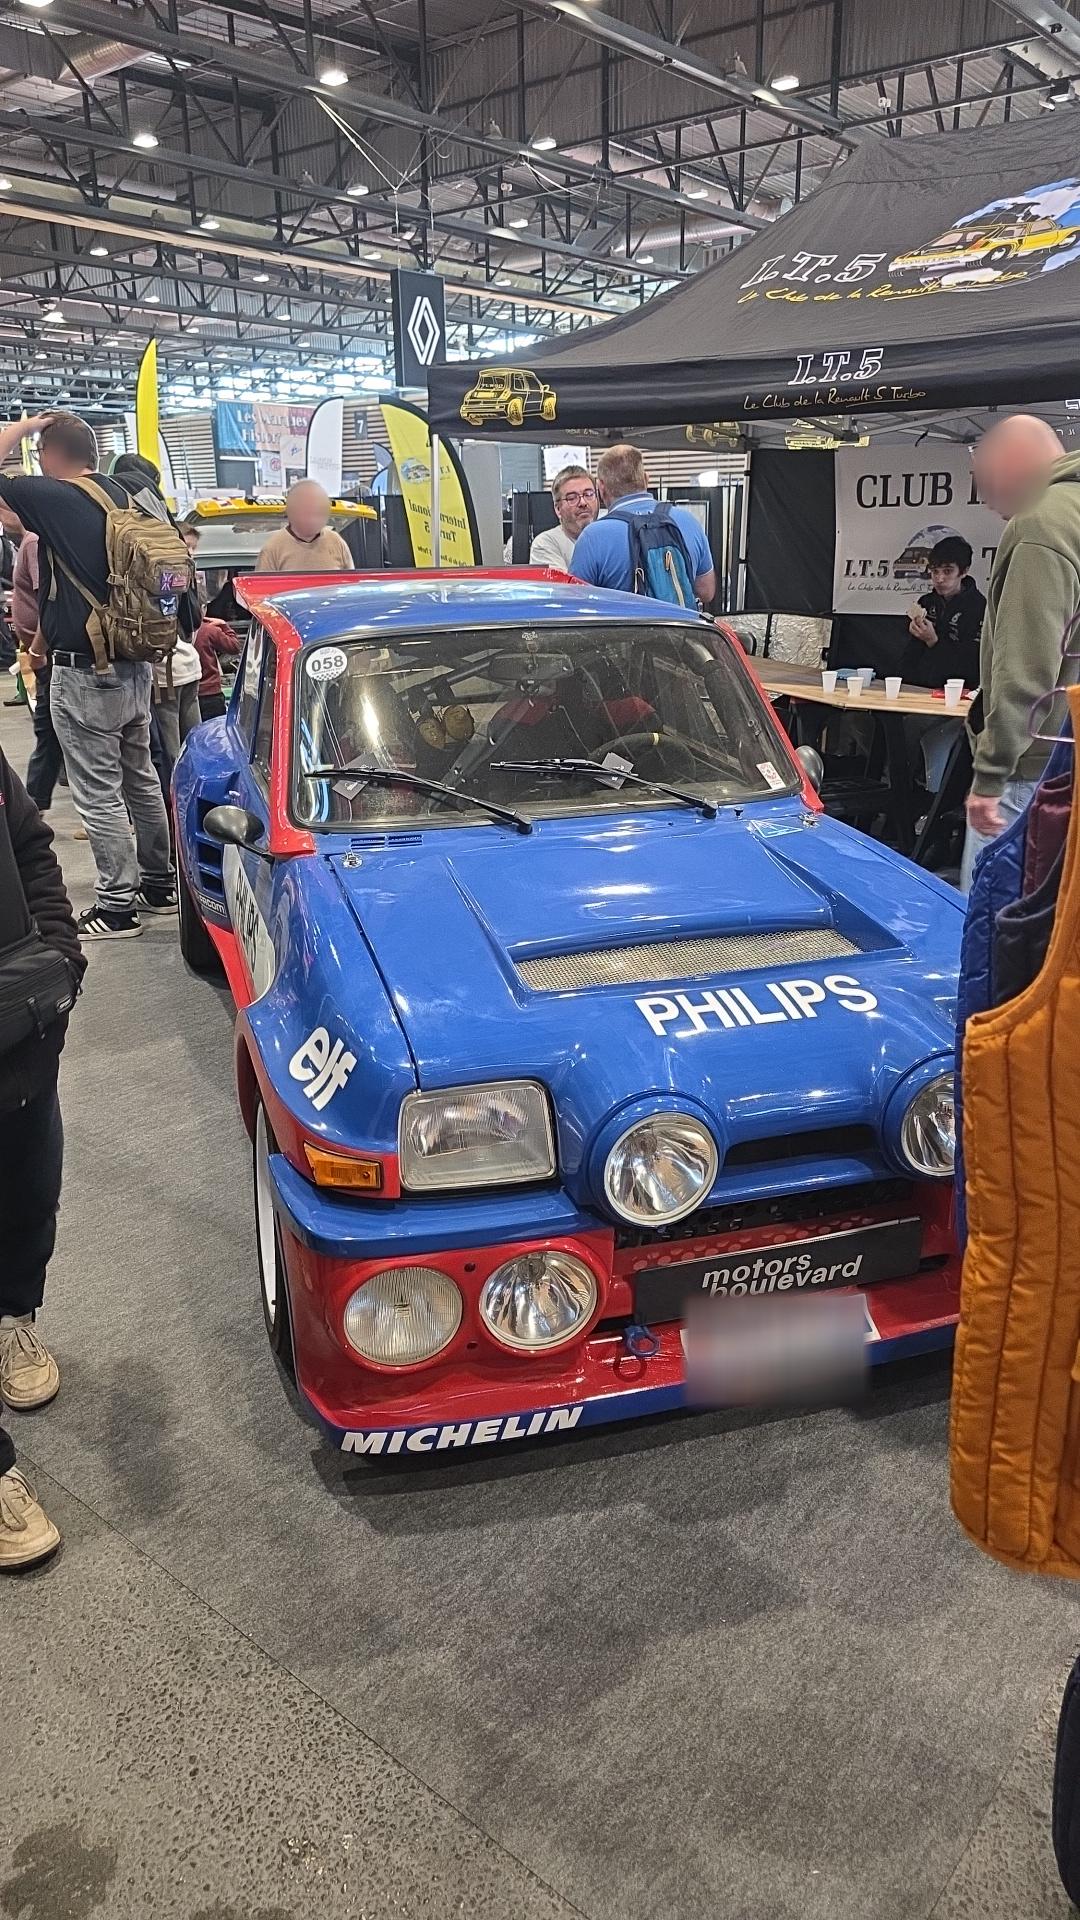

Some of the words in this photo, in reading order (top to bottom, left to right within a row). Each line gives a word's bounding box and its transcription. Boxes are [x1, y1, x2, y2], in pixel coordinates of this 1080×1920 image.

[765, 288, 808, 301] Club
[814, 292, 843, 300] de
[847, 288, 862, 298] la
[788, 348, 884, 385] I.T.5
[743, 395, 760, 410] Le
[763, 394, 790, 408] Club
[794, 396, 813, 407] de
[814, 391, 825, 405] la
[827, 388, 870, 405] Renault
[891, 386, 927, 401] Turbo
[357, 419, 364, 434] 7
[856, 472, 953, 508] CLUB
[844, 559, 889, 577] I.T.5
[311, 655, 344, 672] 058
[634, 974, 878, 1037] PHILIPS
[288, 1027, 358, 1111] elf
[702, 1254, 812, 1288] motors
[709, 1255, 864, 1298] boulevard
[341, 1406, 584, 1455] MICHELIN
